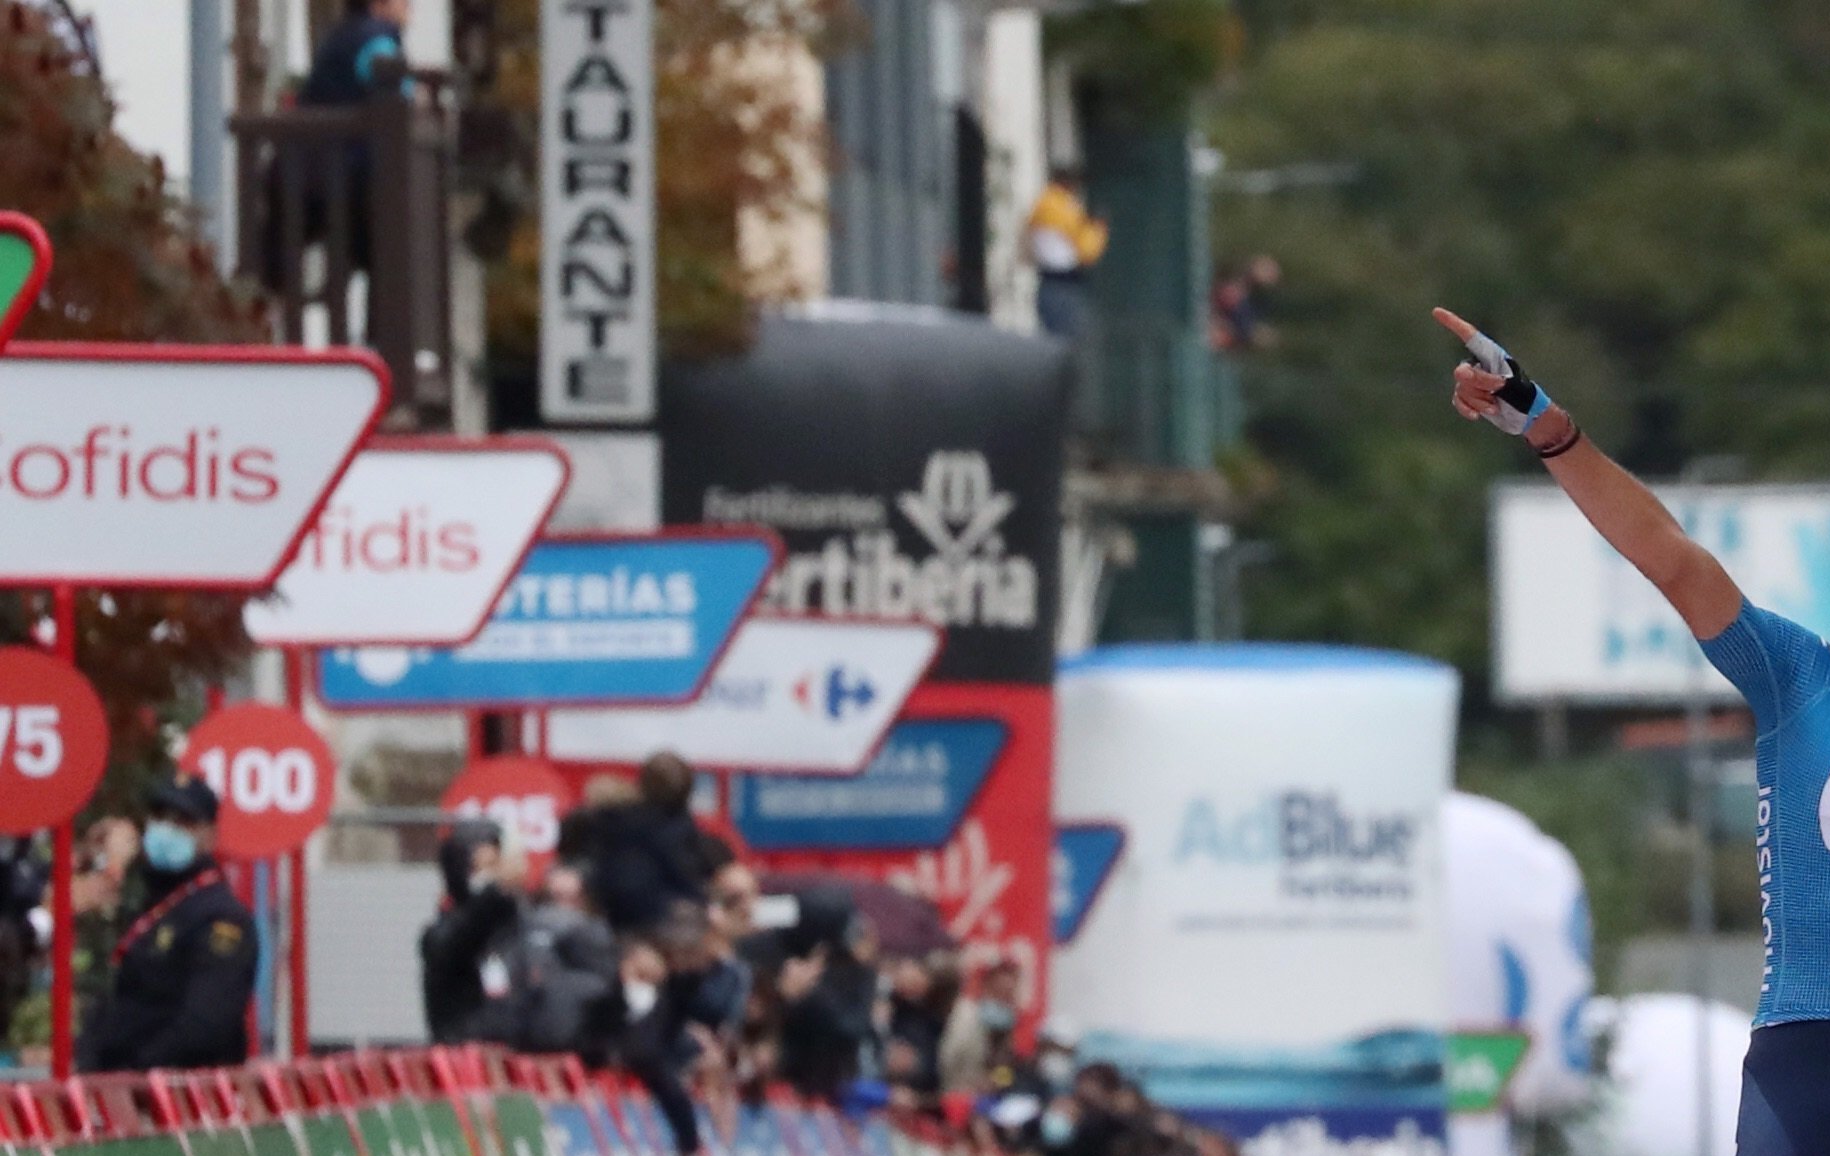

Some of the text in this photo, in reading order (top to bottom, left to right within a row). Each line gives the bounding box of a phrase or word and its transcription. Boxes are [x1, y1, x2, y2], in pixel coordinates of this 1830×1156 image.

[0, 426, 281, 503] ofidis
[308, 505, 482, 573] fidis
[199, 747, 316, 813] 100
